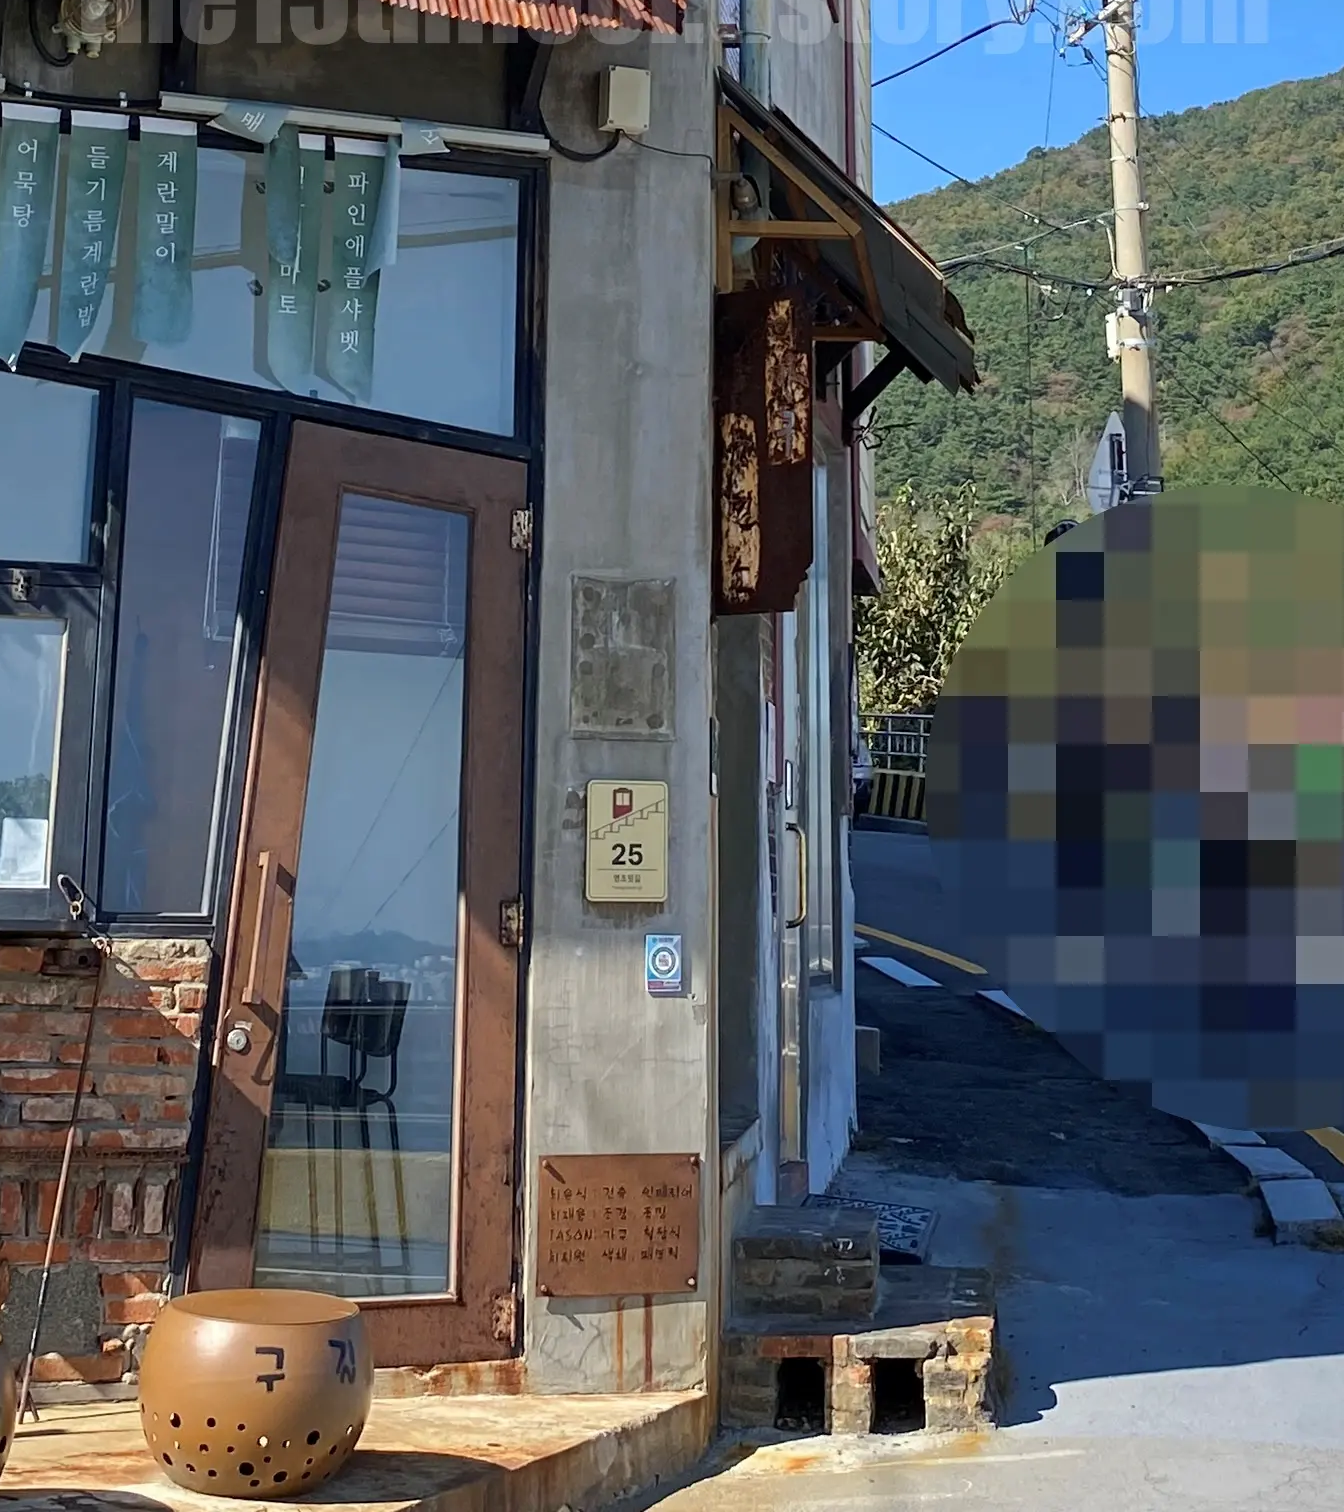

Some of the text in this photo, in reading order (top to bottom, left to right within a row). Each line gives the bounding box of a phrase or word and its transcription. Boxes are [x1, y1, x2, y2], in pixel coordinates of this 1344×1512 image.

[12, 139, 38, 228] 어묵탕
[77, 145, 111, 327] 들기름계란밥
[155, 150, 179, 263] 계란말이
[340, 171, 370, 354] 파인애플샤벳
[611, 842, 644, 866] 25
